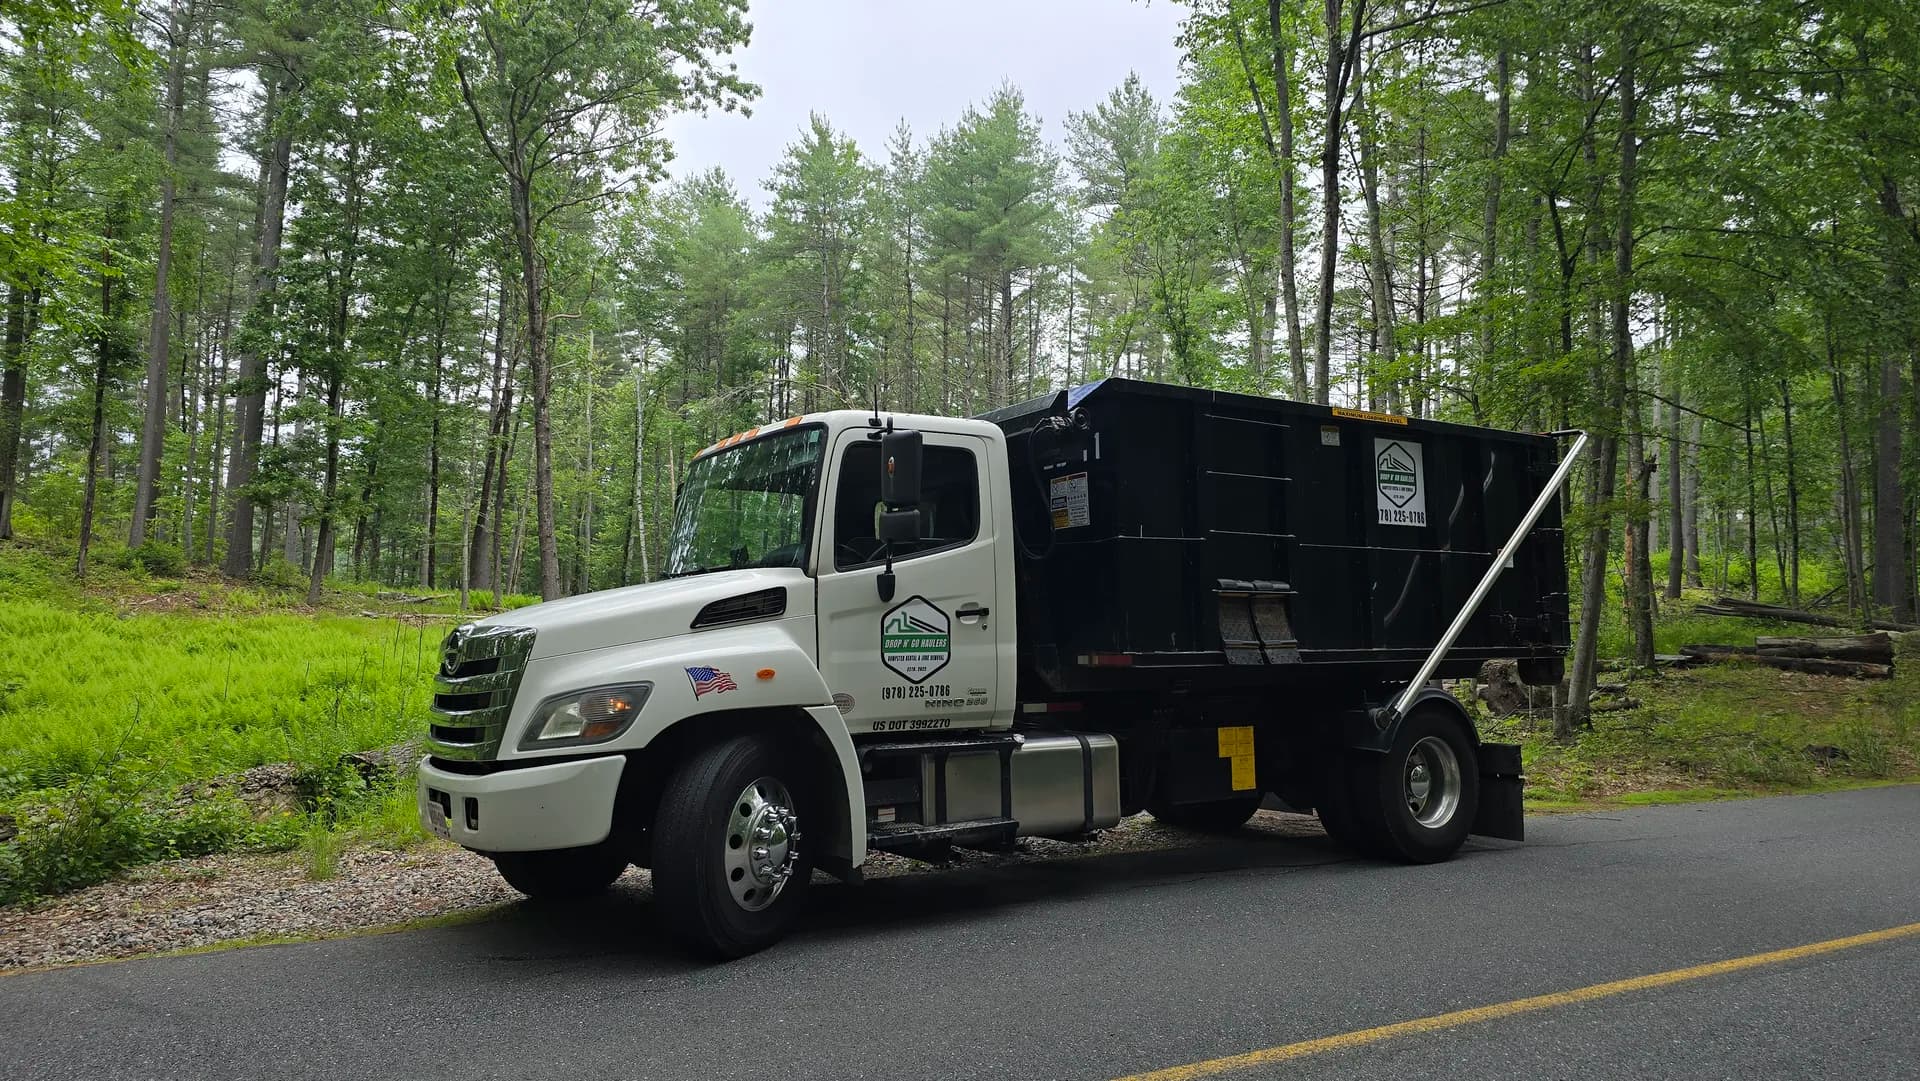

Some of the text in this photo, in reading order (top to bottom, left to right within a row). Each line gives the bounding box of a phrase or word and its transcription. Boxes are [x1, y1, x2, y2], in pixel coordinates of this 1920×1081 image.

[885, 640, 902, 649] DROP
[911, 639, 919, 648] GO
[921, 639, 947, 649] HAULERS
[882, 685, 950, 700] (978) 225-0786
[873, 719, 950, 731] US DOT 3992270
